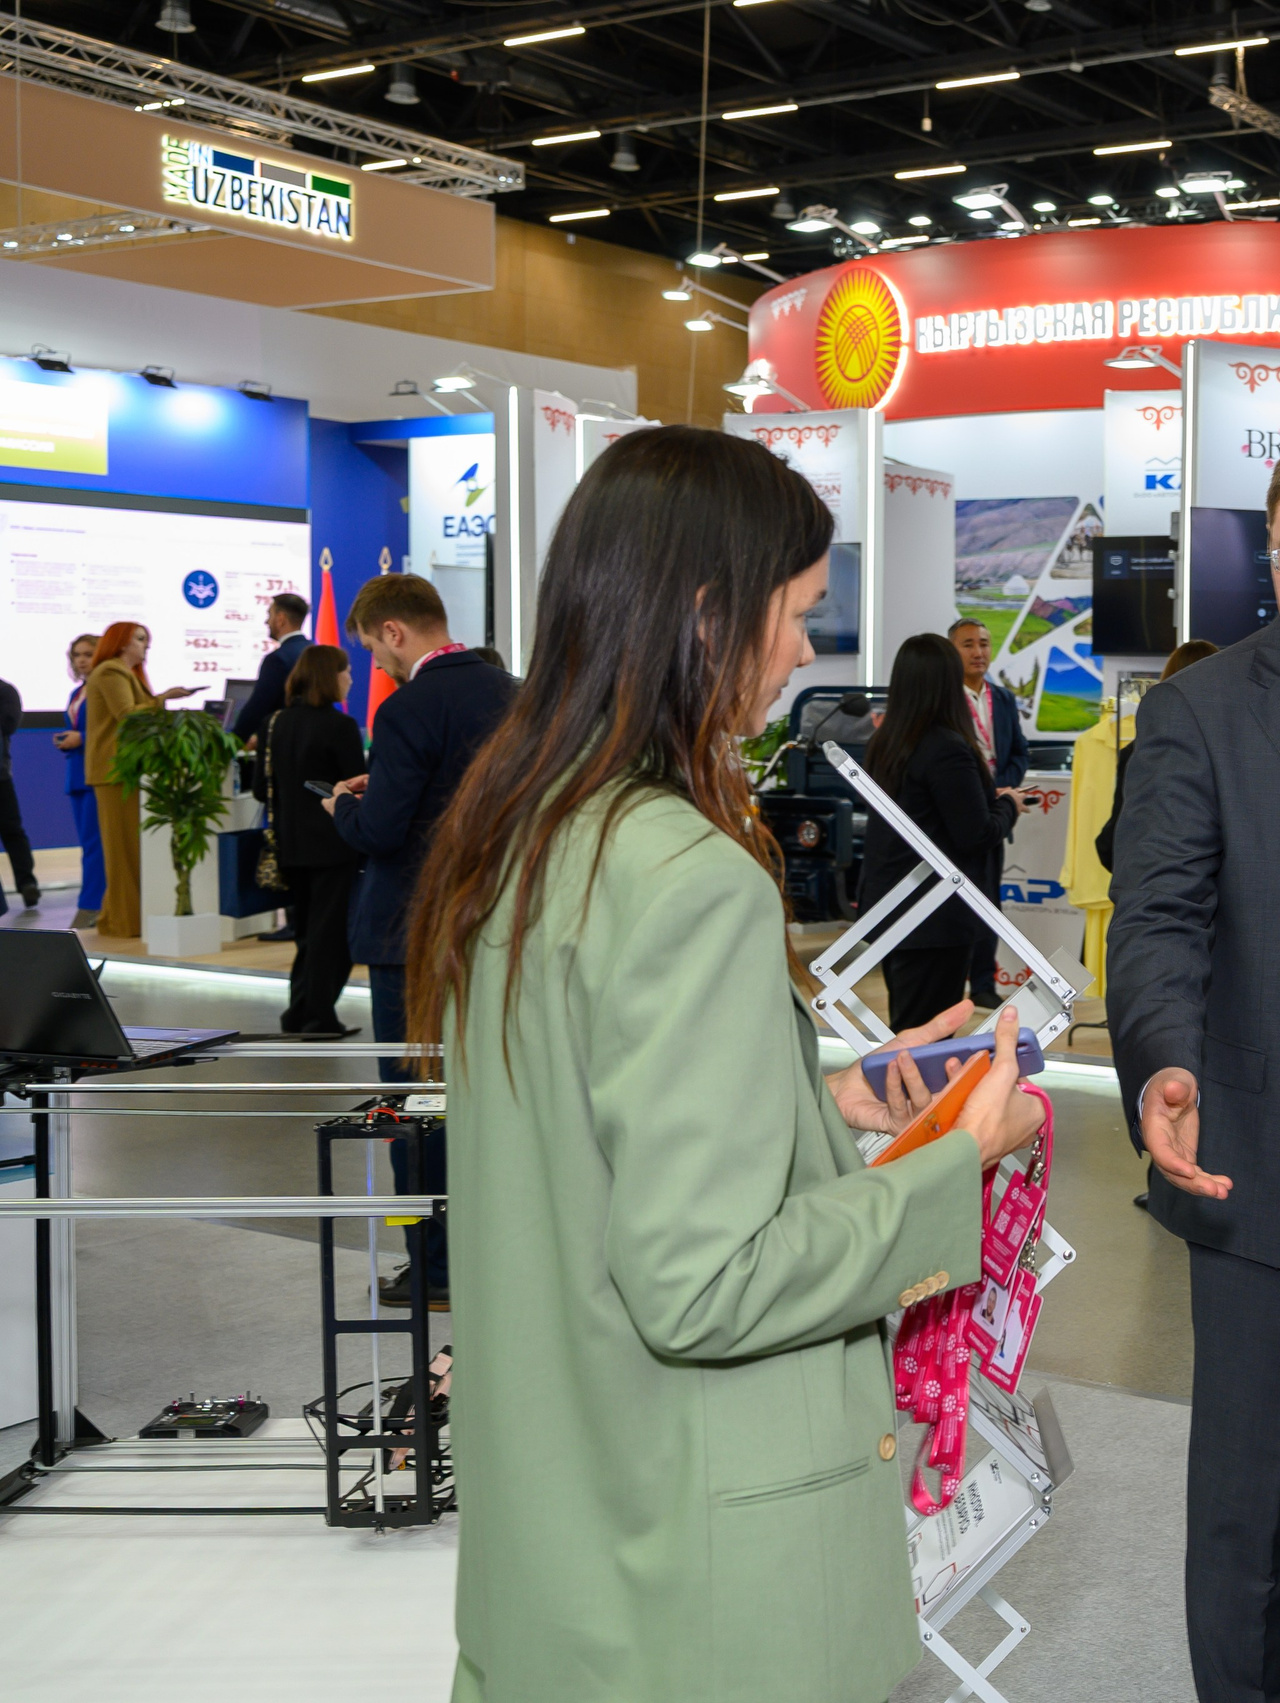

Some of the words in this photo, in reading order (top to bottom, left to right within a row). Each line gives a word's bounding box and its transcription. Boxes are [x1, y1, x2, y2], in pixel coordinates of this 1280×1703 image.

[162, 134, 192, 204] MADE
[191, 165, 352, 237] UZBEKISTAN
[916, 300, 1113, 353] КЫРГЫЗСКАЯ
